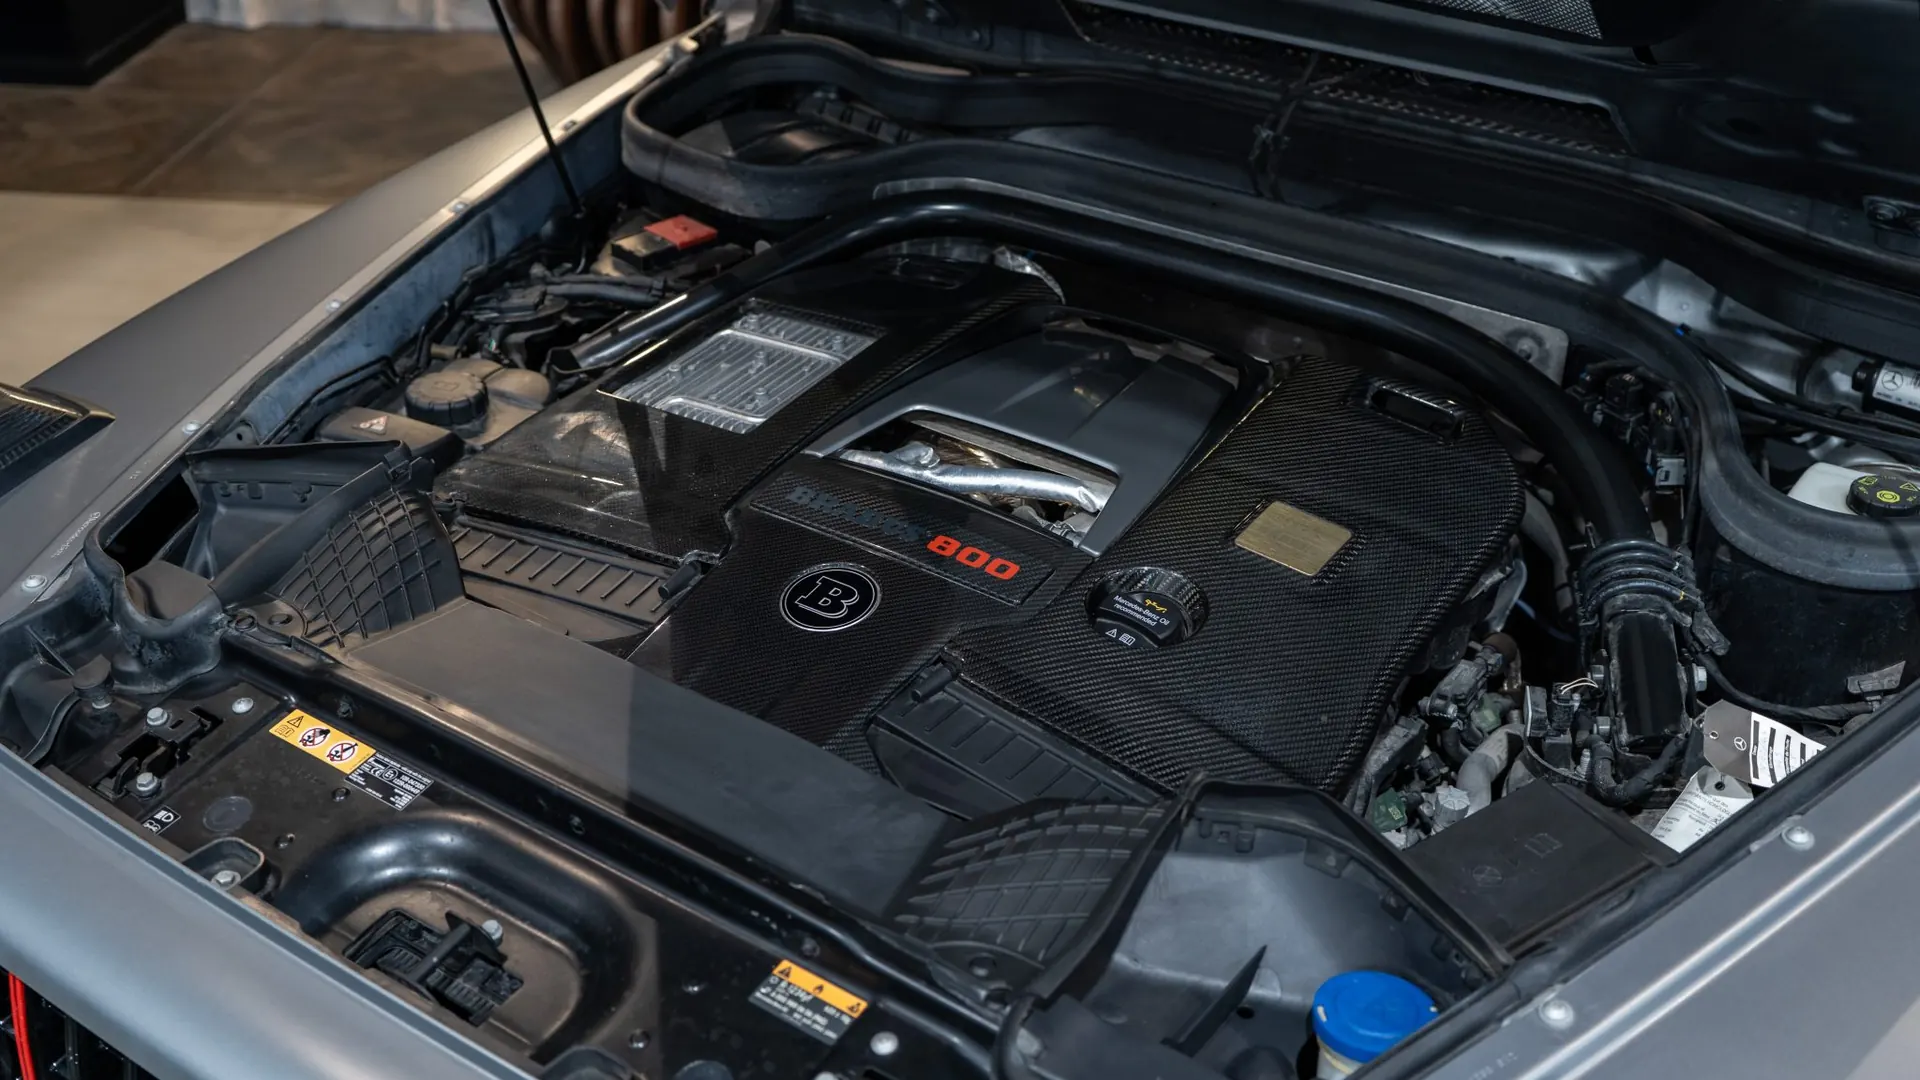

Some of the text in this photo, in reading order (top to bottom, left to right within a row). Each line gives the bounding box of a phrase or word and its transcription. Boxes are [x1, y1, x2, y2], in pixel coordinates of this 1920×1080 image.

[926, 535, 1021, 581] 800
[795, 575, 860, 619] B
[1113, 595, 1170, 626] Mercedes-Benz Oil
[1113, 603, 1158, 627] recommended
